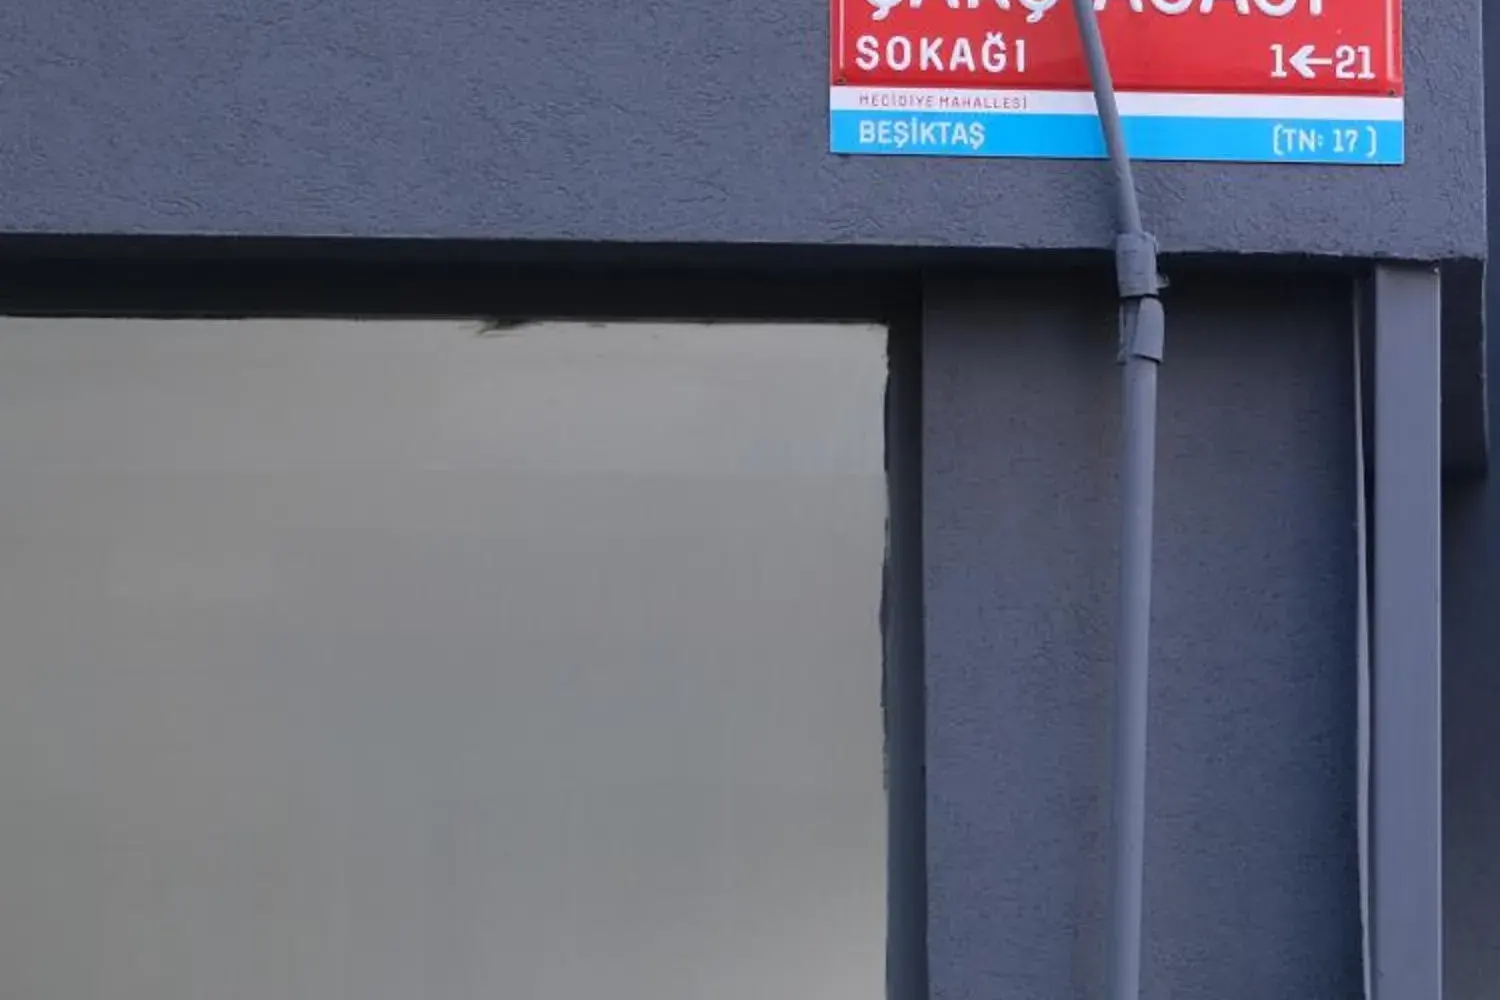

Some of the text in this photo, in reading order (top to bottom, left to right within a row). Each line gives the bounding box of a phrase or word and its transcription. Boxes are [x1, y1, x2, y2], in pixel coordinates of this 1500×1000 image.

[855, 32, 1026, 73] SOKAĞI
[1335, 44, 1376, 79] 21
[859, 93, 1028, 110] MECİDİYE MAHALLESİ
[859, 117, 986, 150] BEŞİKTAŞ
